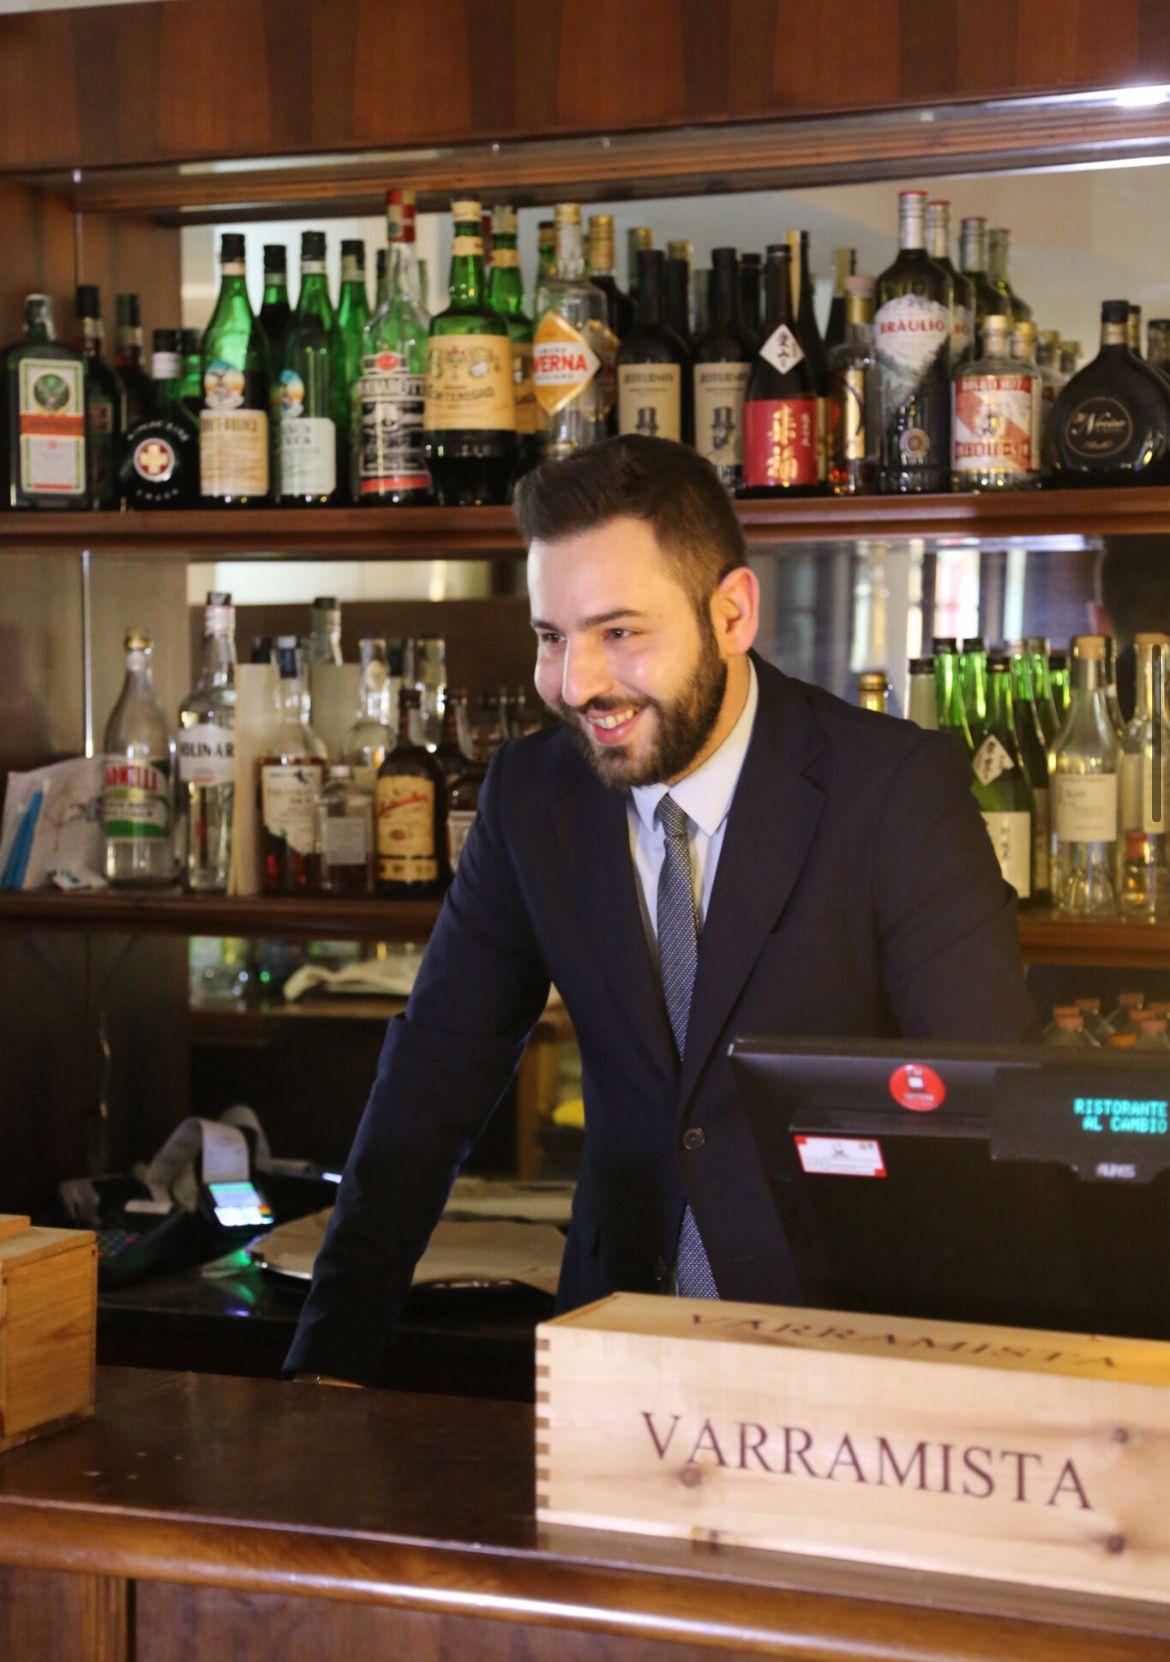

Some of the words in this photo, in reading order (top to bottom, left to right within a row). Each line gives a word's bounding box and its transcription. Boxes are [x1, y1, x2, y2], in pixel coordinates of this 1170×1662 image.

[880, 319, 945, 335] BRAULIO
[532, 354, 588, 373] VERNA
[180, 742, 234, 758] MOLINAR
[1073, 1098, 1168, 1117] RISTORANTE
[1082, 1115, 1103, 1132] AL
[1110, 1115, 1168, 1134] CAMBIO
[691, 1313, 1117, 1369] VARRAMISTA
[641, 1411, 1094, 1511] VARRAMISTA
